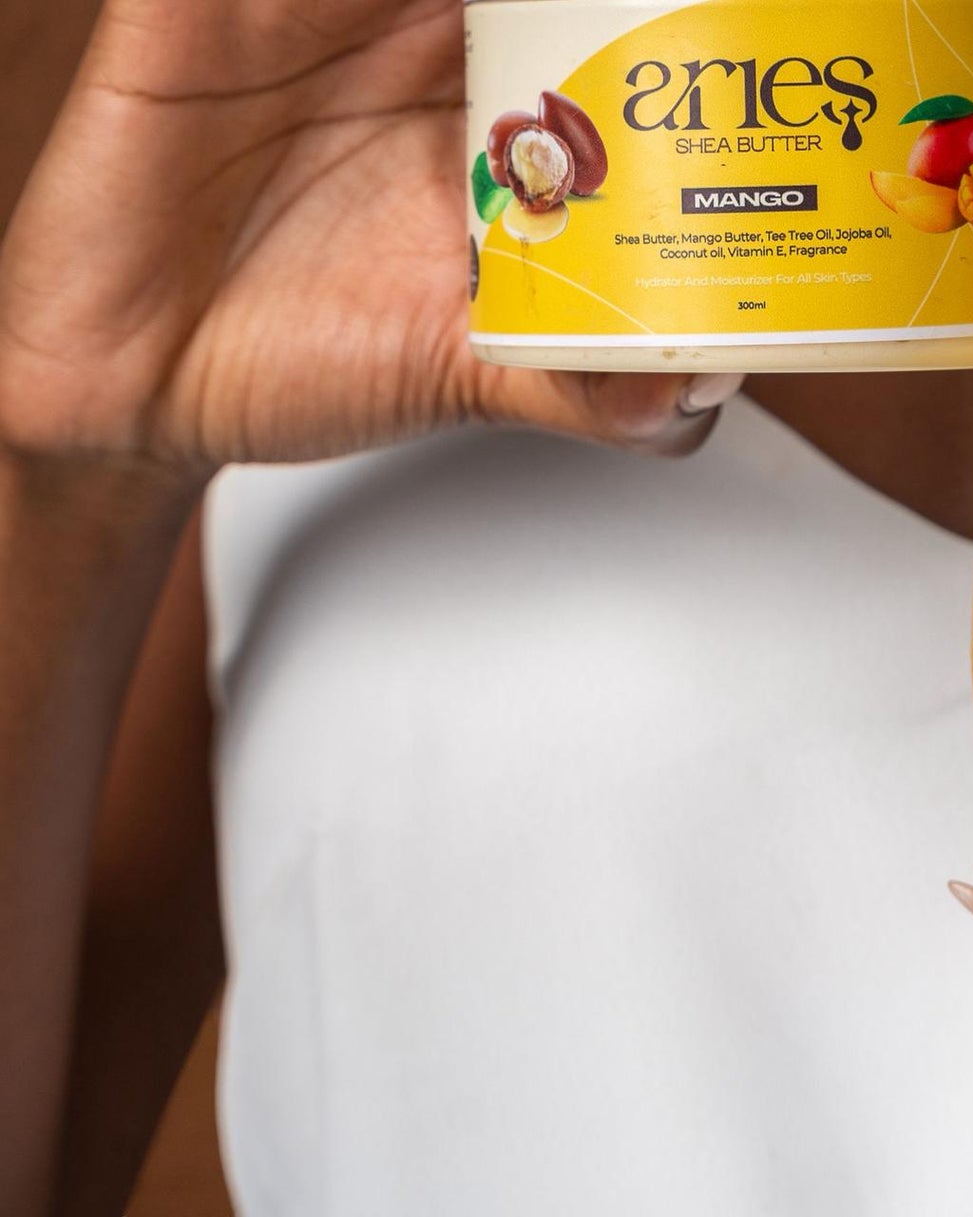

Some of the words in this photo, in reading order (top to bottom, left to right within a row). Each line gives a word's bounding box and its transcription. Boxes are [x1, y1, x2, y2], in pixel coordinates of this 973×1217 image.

[623, 56, 877, 132] aries
[675, 137, 733, 153] SHEA
[737, 135, 823, 152] BUTTER
[694, 190, 804, 208] MANGO
[615, 234, 640, 245] Shea
[643, 233, 679, 244] Butter,
[681, 233, 722, 245] Mango
[725, 232, 764, 242] Butter,
[766, 231, 786, 241] Tee
[788, 230, 813, 240] Tree
[816, 229, 833, 242] Oil,
[836, 228, 872, 241] Jojoba
[874, 227, 892, 239] Oil,
[660, 248, 708, 259] Coconut
[710, 247, 726, 259] oil,
[728, 246, 774, 257] Vitamin
[776, 246, 787, 258] E,
[789, 245, 847, 257] Fragrance
[636, 277, 681, 287] Hydrator
[686, 277, 707, 286] And
[777, 275, 793, 283] For
[798, 274, 811, 282] All
[814, 274, 836, 282] Skin
[840, 272, 871, 284] Types
[738, 301, 766, 310] 300ml
